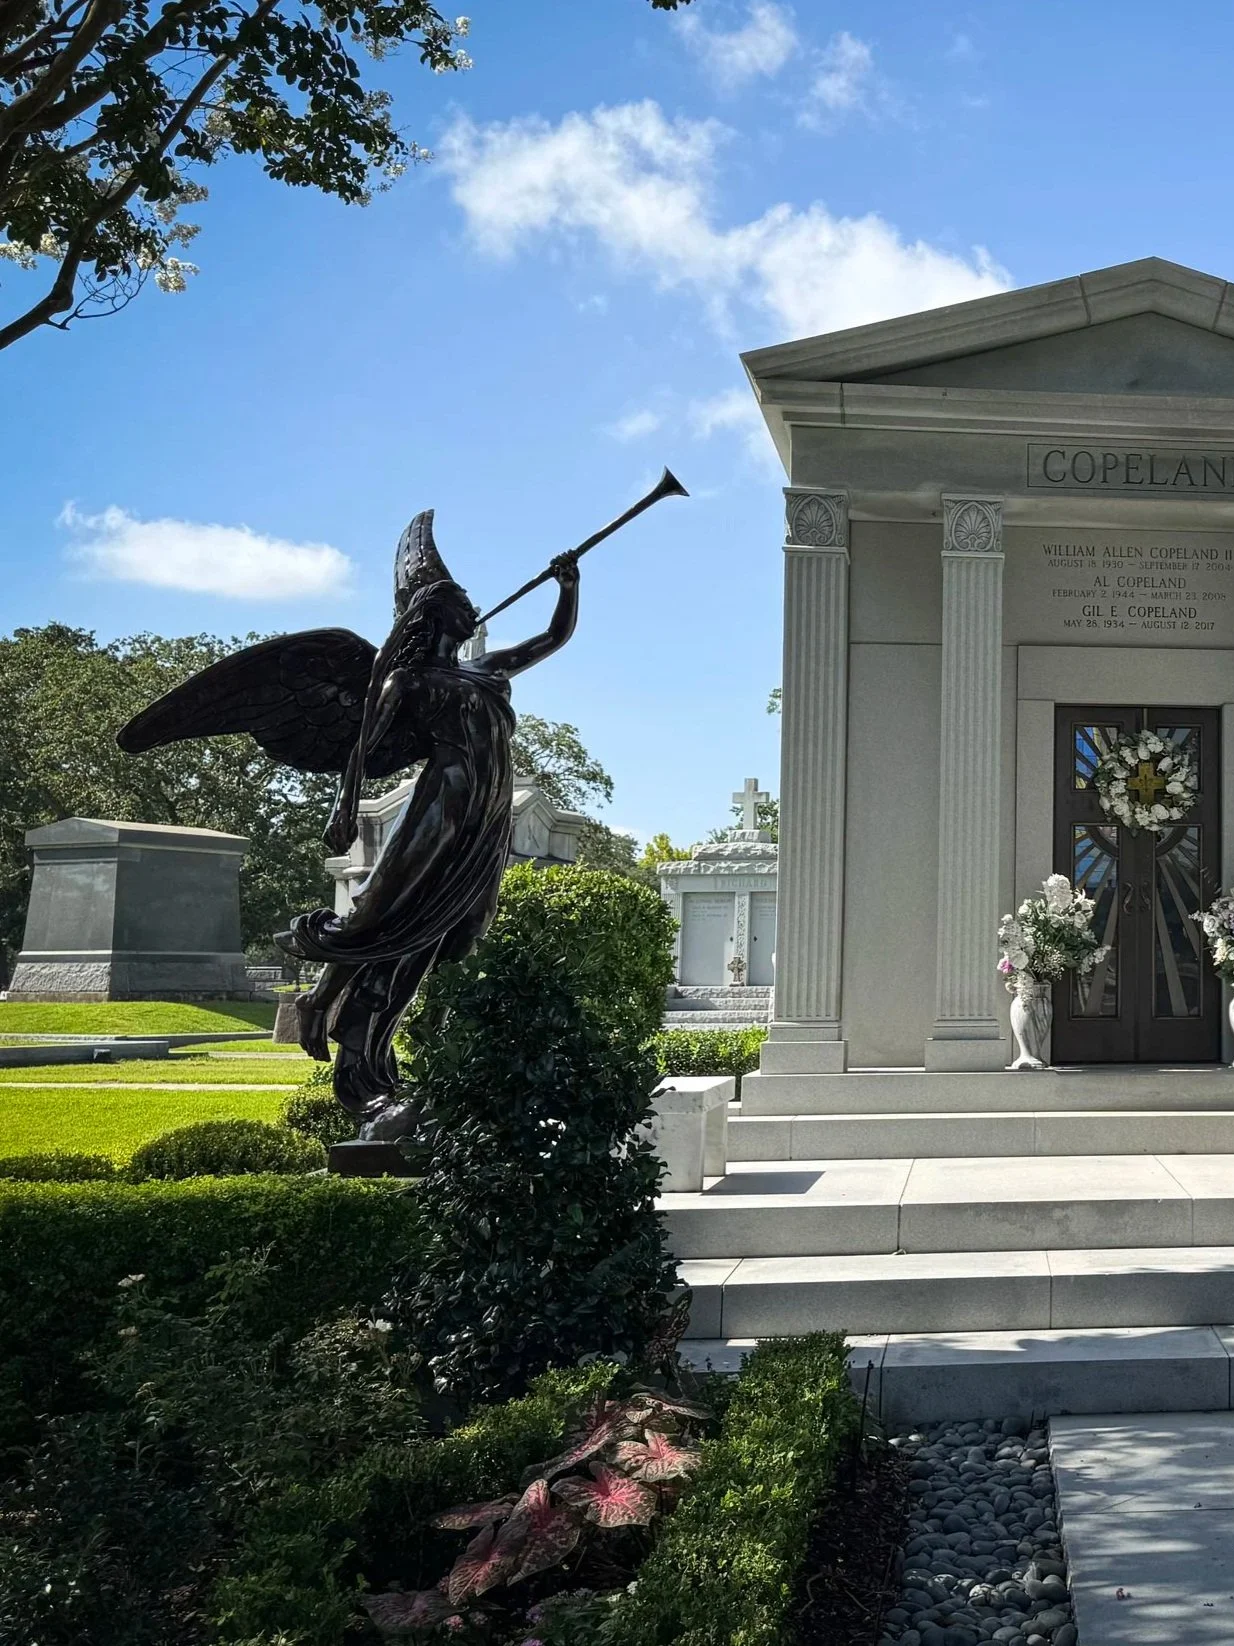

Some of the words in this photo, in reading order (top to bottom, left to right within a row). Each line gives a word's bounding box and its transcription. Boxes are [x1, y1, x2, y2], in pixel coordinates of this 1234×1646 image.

[1042, 544, 1095, 557] WILLIAM
[1103, 546, 1144, 558] ALLEN
[1150, 547, 1219, 560] COPELAND
[1047, 559, 1083, 568] AUGUST
[1139, 561, 1188, 570] SEPTEMBER
[1093, 576, 1110, 588] AL
[1117, 576, 1187, 589] COPELAND
[1052, 589, 1097, 598] FEBRUARY
[1150, 592, 1182, 600] MARCH
[1082, 605, 1105, 617] GIL
[1127, 606, 1197, 619] COPELAND
[1063, 620, 1082, 628] MAY
[1103, 620, 1125, 629] 1934
[1140, 621, 1176, 629] AUGUST
[1195, 622, 1215, 631] 2017
